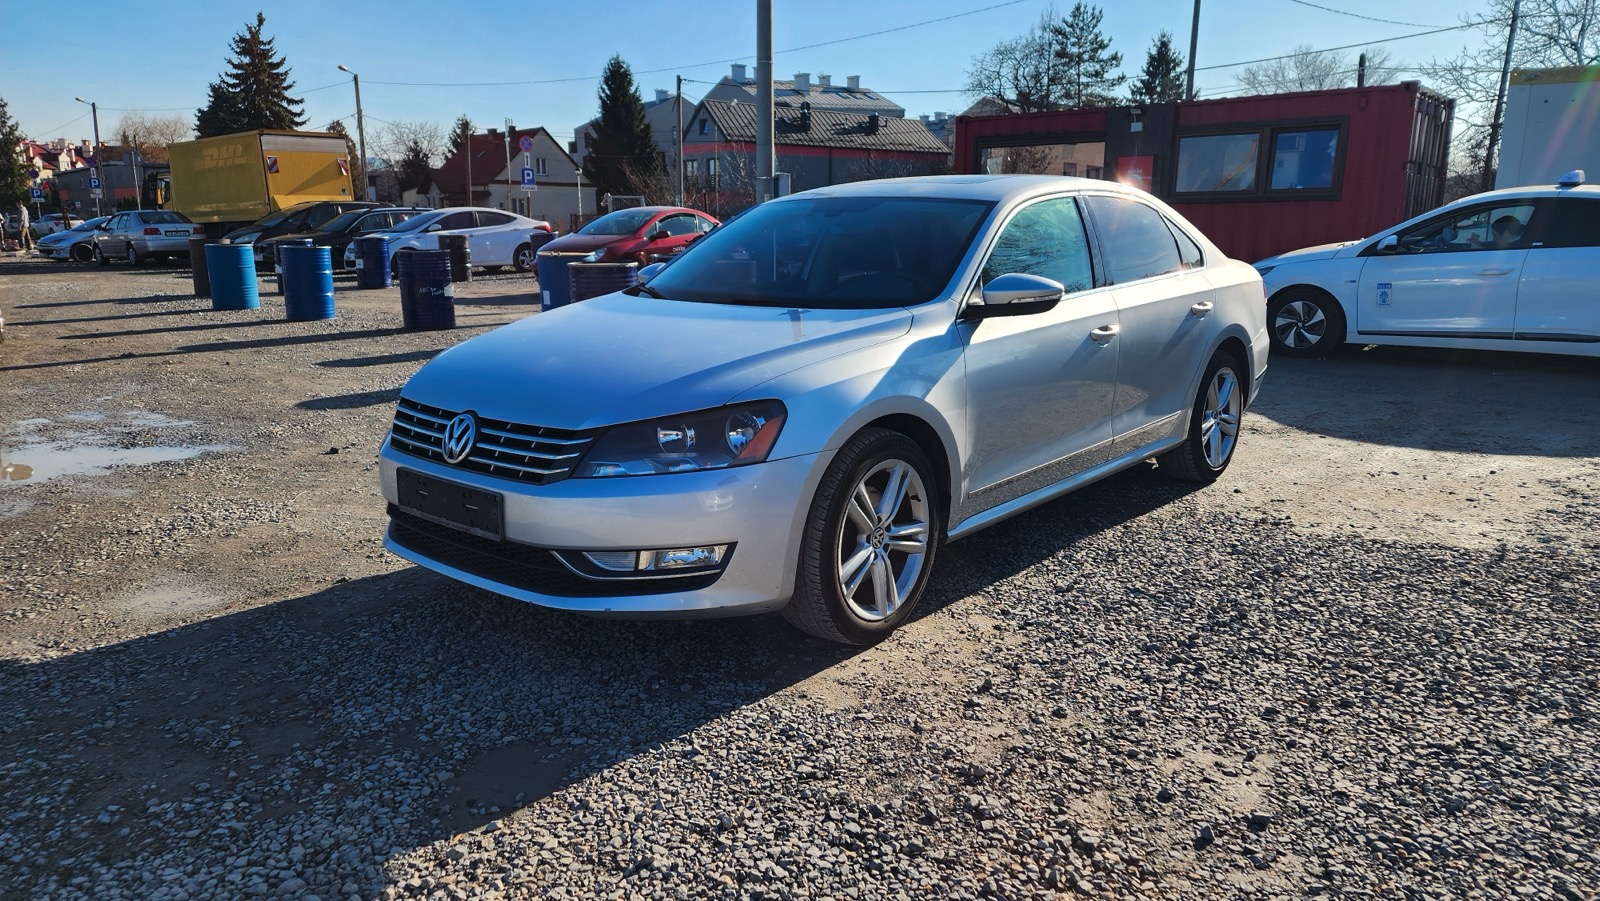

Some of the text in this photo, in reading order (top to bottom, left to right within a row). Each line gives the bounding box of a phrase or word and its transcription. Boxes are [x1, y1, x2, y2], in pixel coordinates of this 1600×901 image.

[203, 144, 248, 169] DHL
[524, 170, 533, 183] P
[91, 179, 98, 188] P
[33, 189, 41, 198] P
[443, 413, 475, 463] VW
